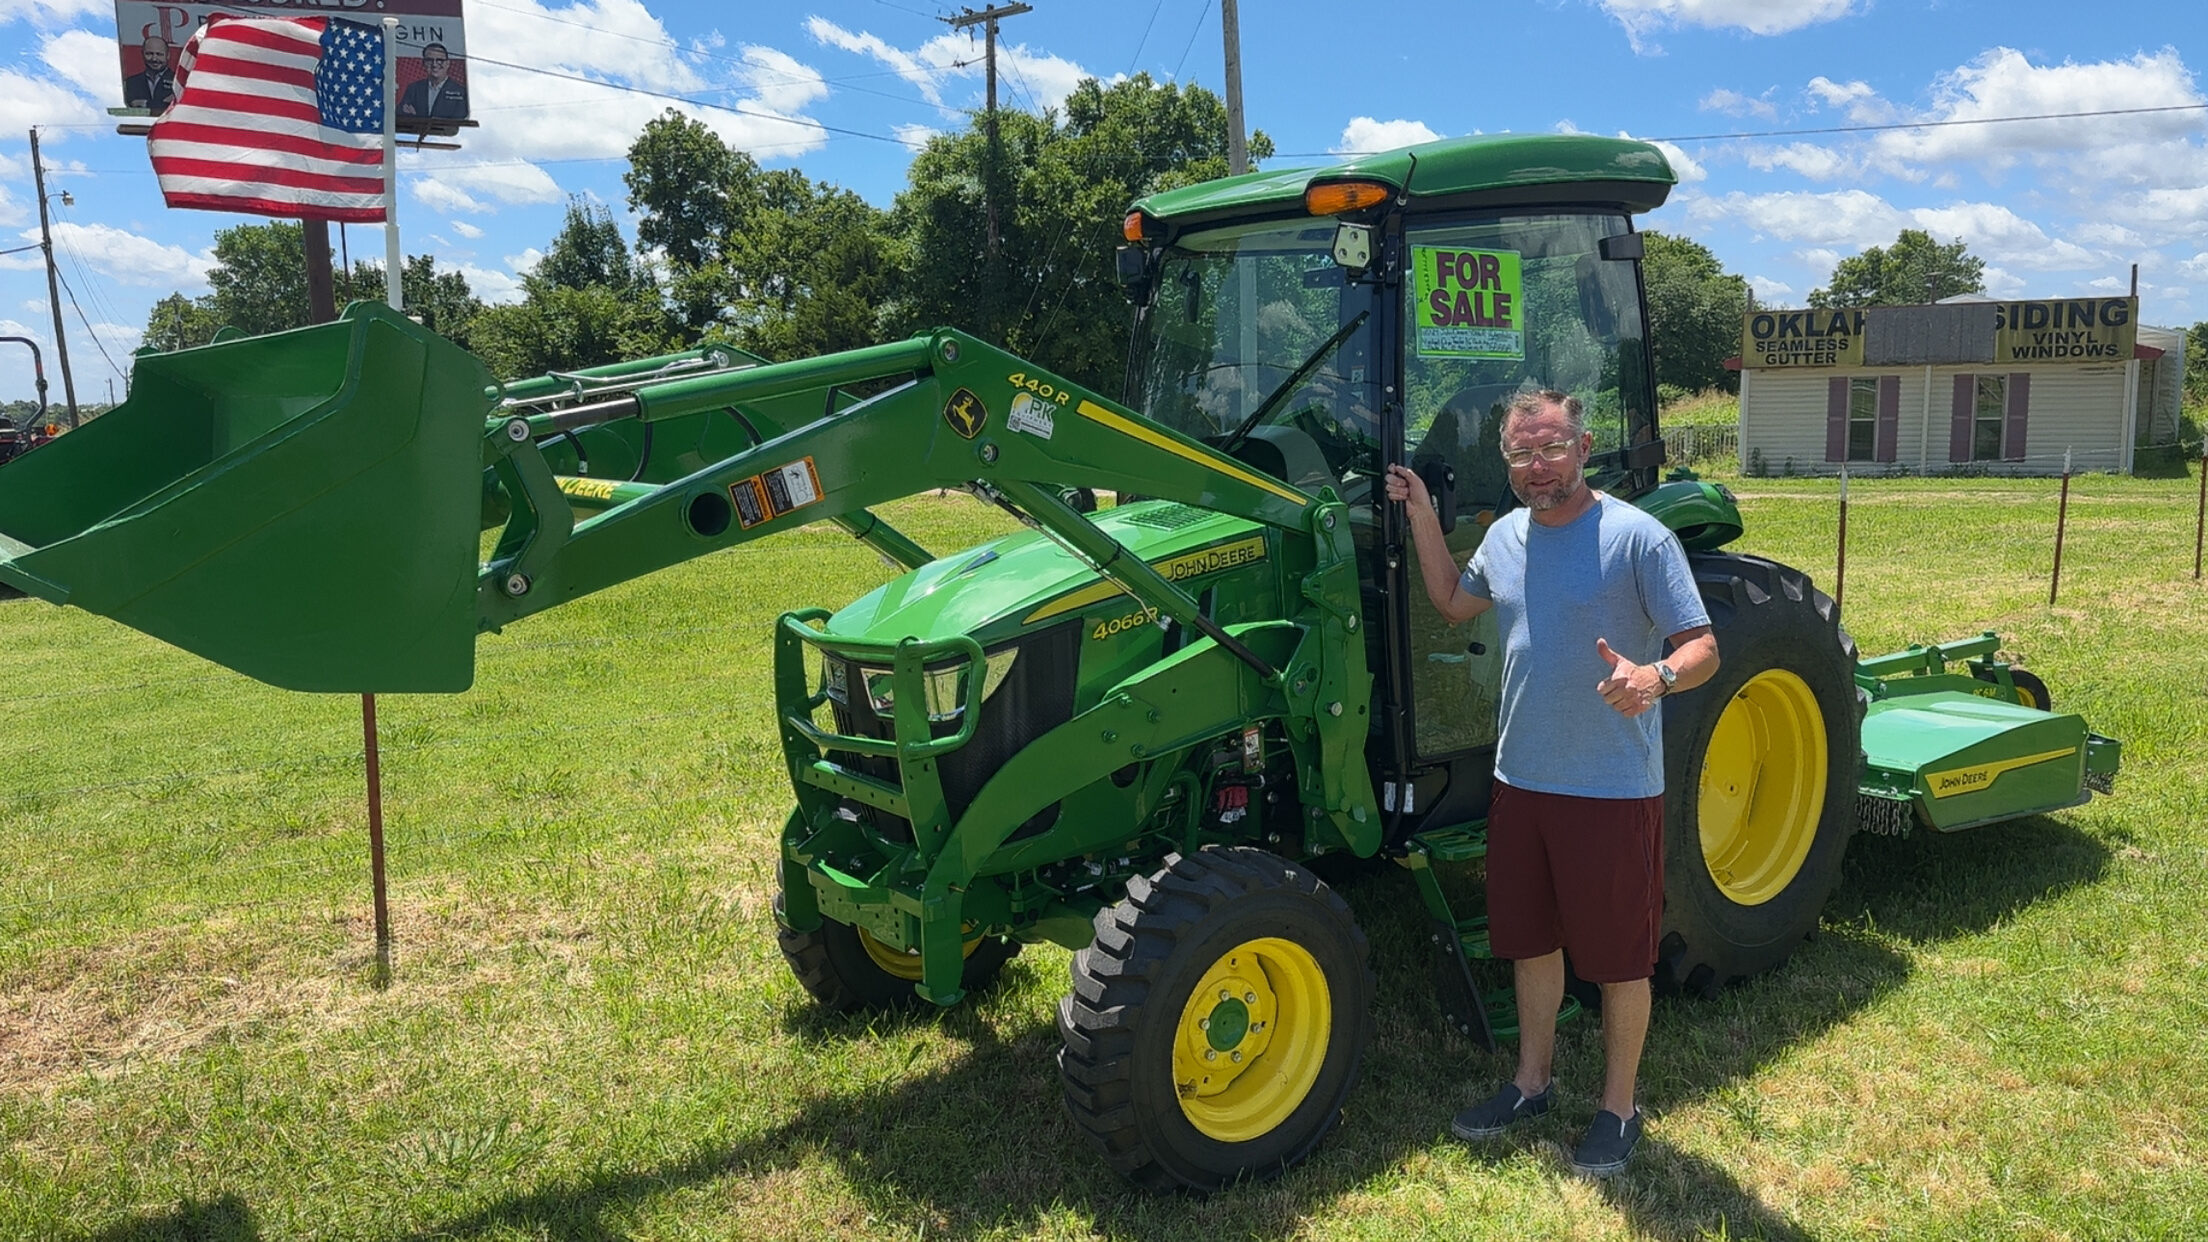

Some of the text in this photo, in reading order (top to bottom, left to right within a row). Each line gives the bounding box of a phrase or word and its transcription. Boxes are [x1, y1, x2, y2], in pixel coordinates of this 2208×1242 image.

[396, 25, 443, 41] GHN
[1436, 251, 1501, 291] FOR
[1429, 288, 1512, 328] SALE
[1756, 339, 1849, 352] SEAMLESS
[2032, 331, 2098, 345] VINYL
[1765, 352, 1836, 365] GUTTER
[2012, 344, 2118, 359] WINDOWS
[1166, 545, 1256, 582] JOHN DEERE
[1961, 771, 1988, 785] DEERE
